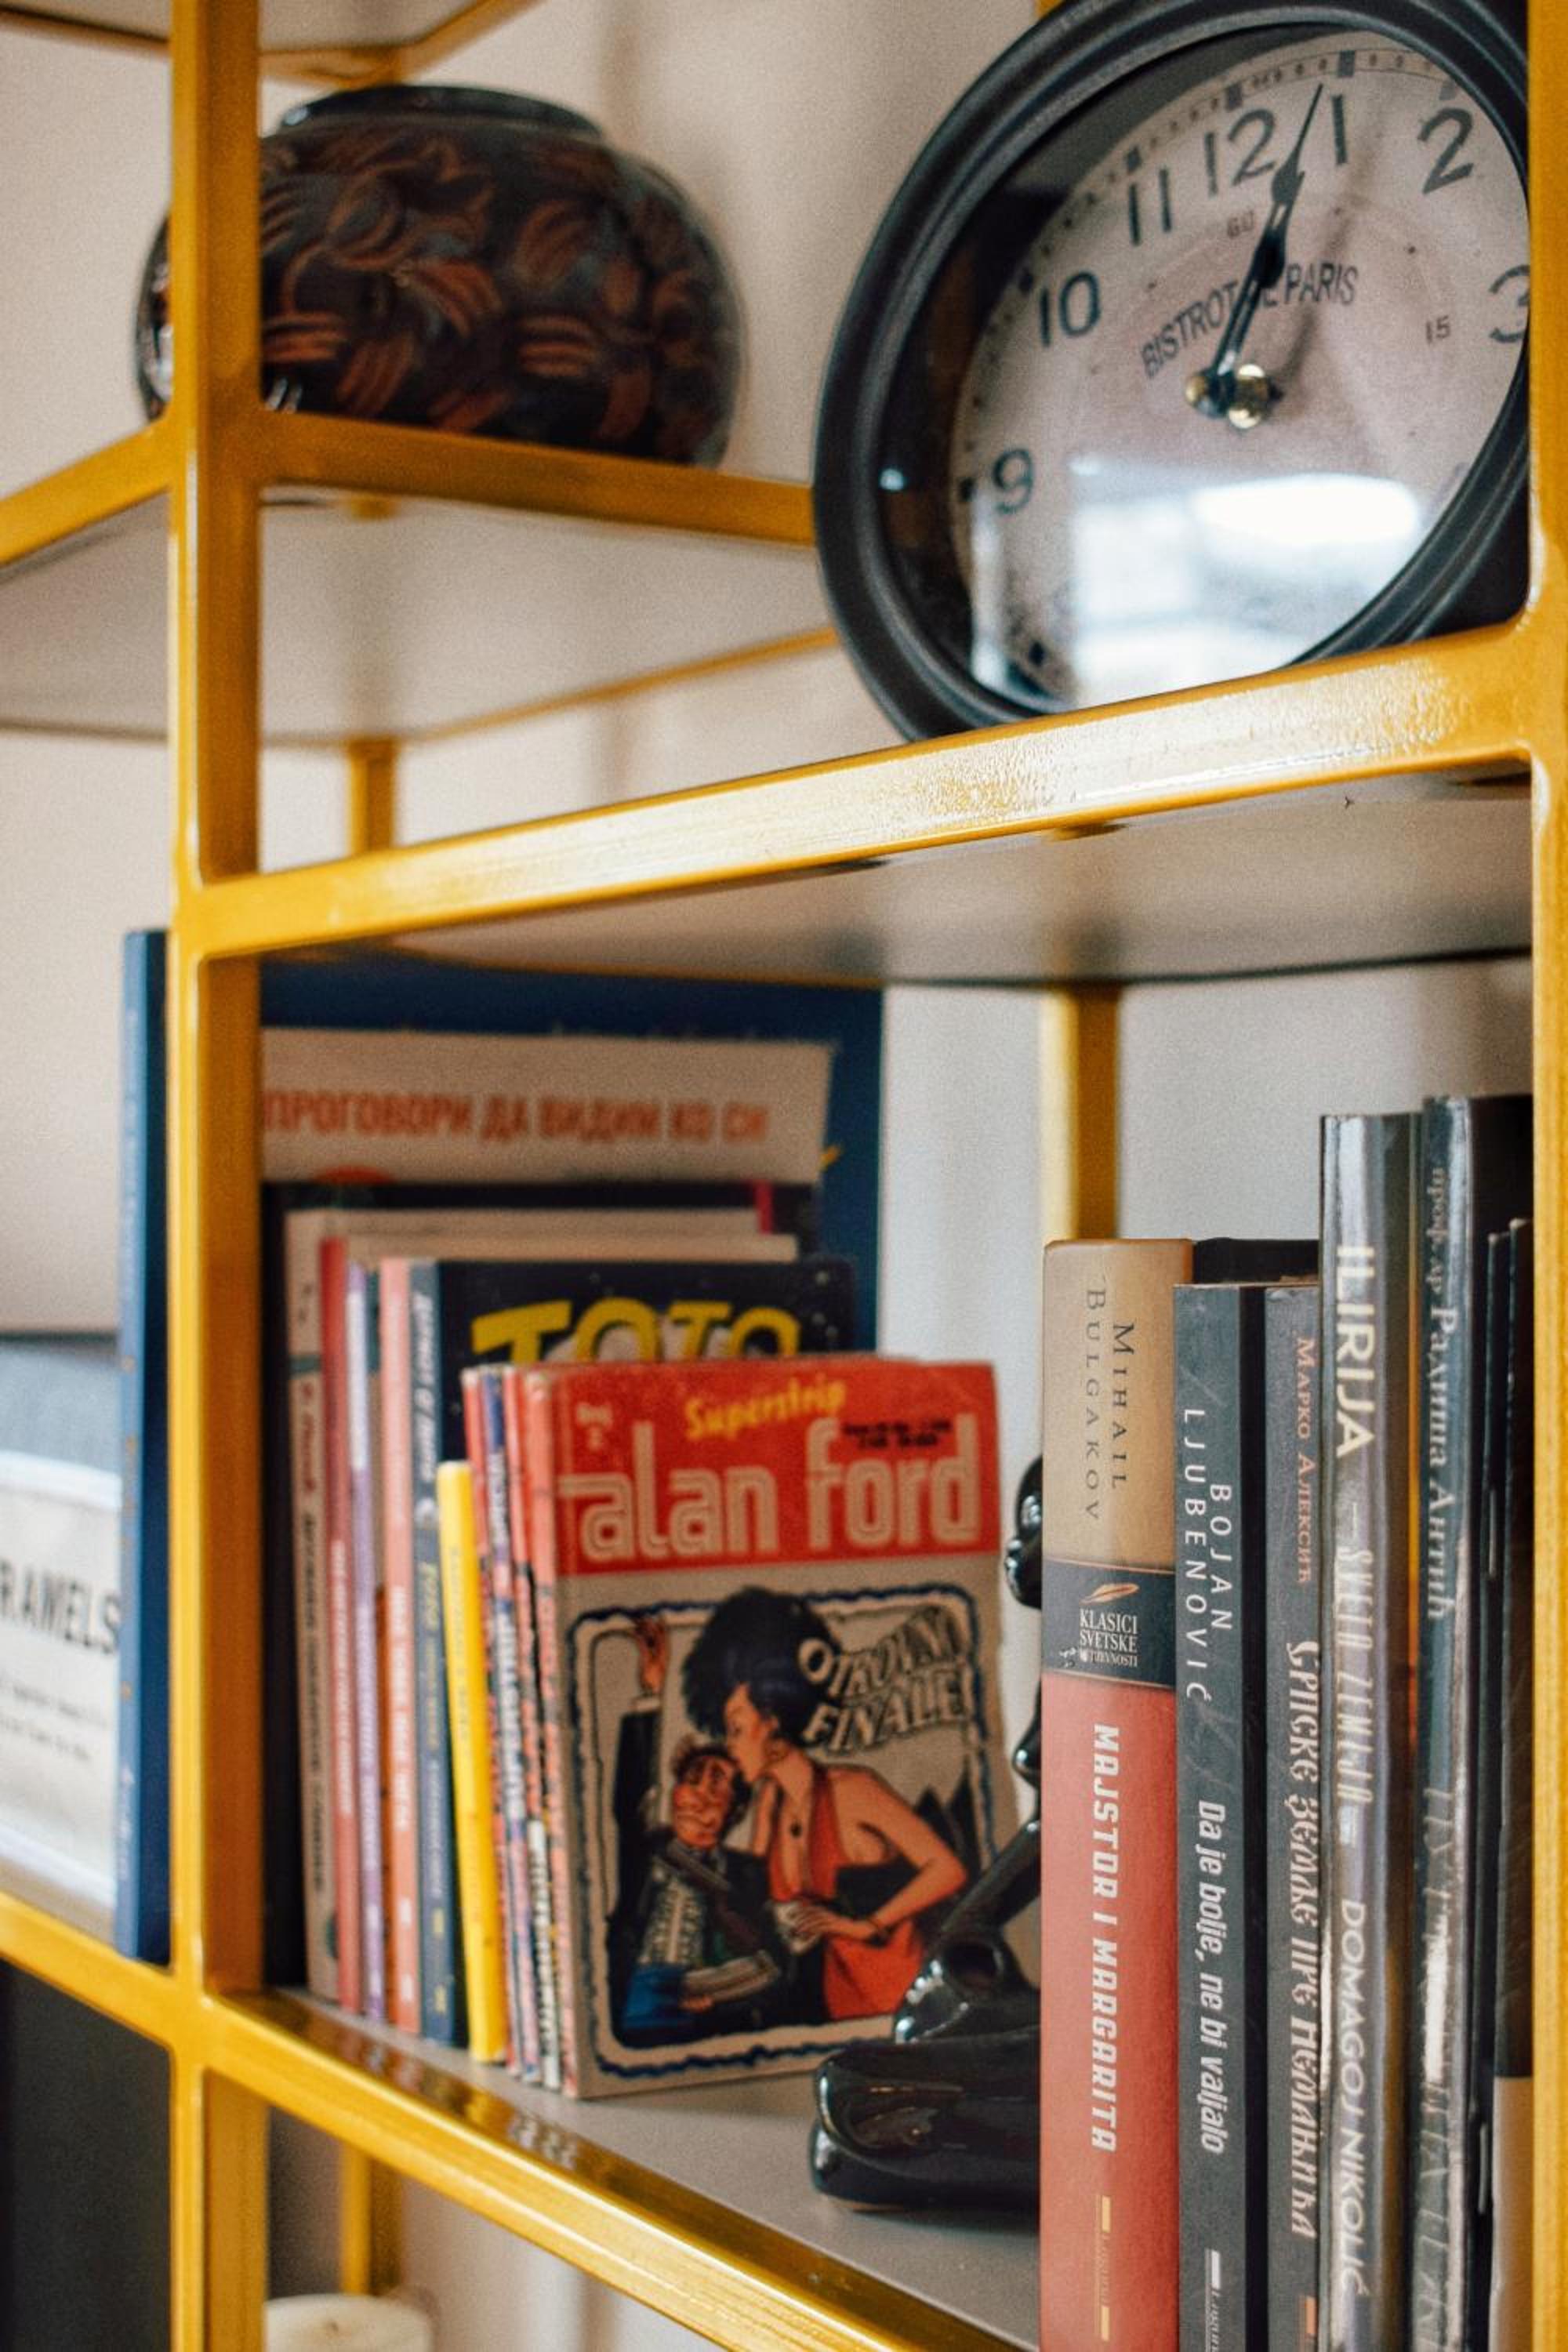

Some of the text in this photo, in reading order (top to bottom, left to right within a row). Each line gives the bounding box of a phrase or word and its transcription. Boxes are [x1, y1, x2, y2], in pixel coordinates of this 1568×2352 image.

[1203, 108, 1276, 198] 12
[1332, 93, 1348, 165] 1
[1417, 107, 1474, 195] 2
[1127, 166, 1171, 246] 11
[1036, 271, 1101, 347] 10
[1140, 279, 1239, 379] BISTROT
[1283, 262, 1359, 306] PARIS
[1425, 317, 1452, 343] 15
[1489, 264, 1530, 343] 3
[991, 448, 1034, 514] 9
[1084, 1288, 1107, 1520] BULGAKOV
[1111, 1323, 1135, 1489] MIHAIL
[1335, 1245, 1376, 1458] ILIRIJA
[557, 1421, 779, 1563] alan
[807, 1414, 981, 1550] ford
[1183, 1408, 1213, 1702] LJUBENOVIĆ
[1210, 1484, 1232, 1630] BOJAN
[1427, 1484, 1457, 1620] Антић
[1079, 1607, 1138, 1635] KLASICI
[1079, 1628, 1138, 1653] SVETSKE
[1334, 1546, 1374, 1804] SVETA ZEMLJA
[802, 1661, 973, 1751] FINALE
[1091, 1723, 1120, 2153] MAJSTOR I MARGARITA
[1195, 1800, 1229, 2155] Da je bolje, ne bi valjalo
[1339, 1899, 1370, 2296] DOMAGOJ NIKOLIĆ
